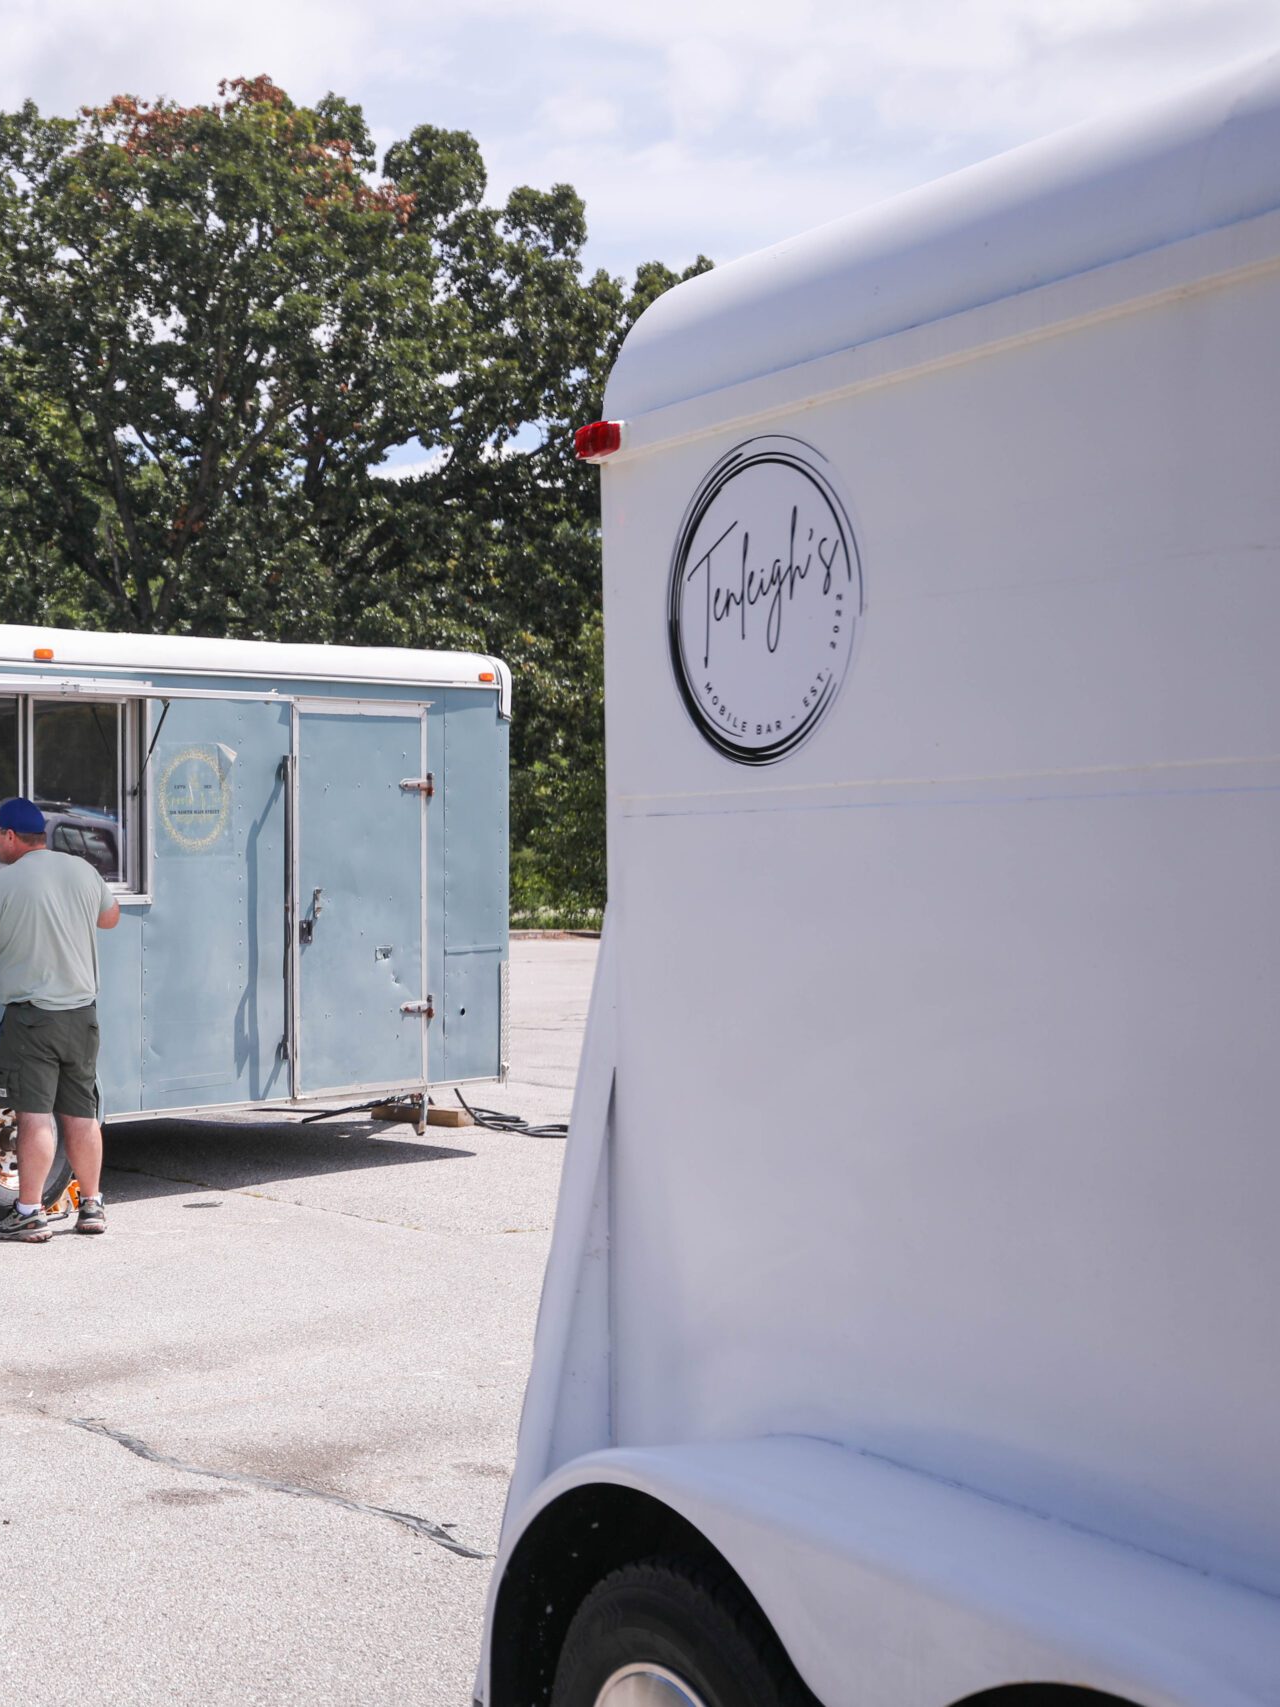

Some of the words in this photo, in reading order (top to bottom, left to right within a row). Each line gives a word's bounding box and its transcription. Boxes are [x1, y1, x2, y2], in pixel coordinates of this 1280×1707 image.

[687, 505, 839, 669] Tenleigh's
[704, 682, 748, 732] MOBILE
[756, 719, 782, 735] BAR
